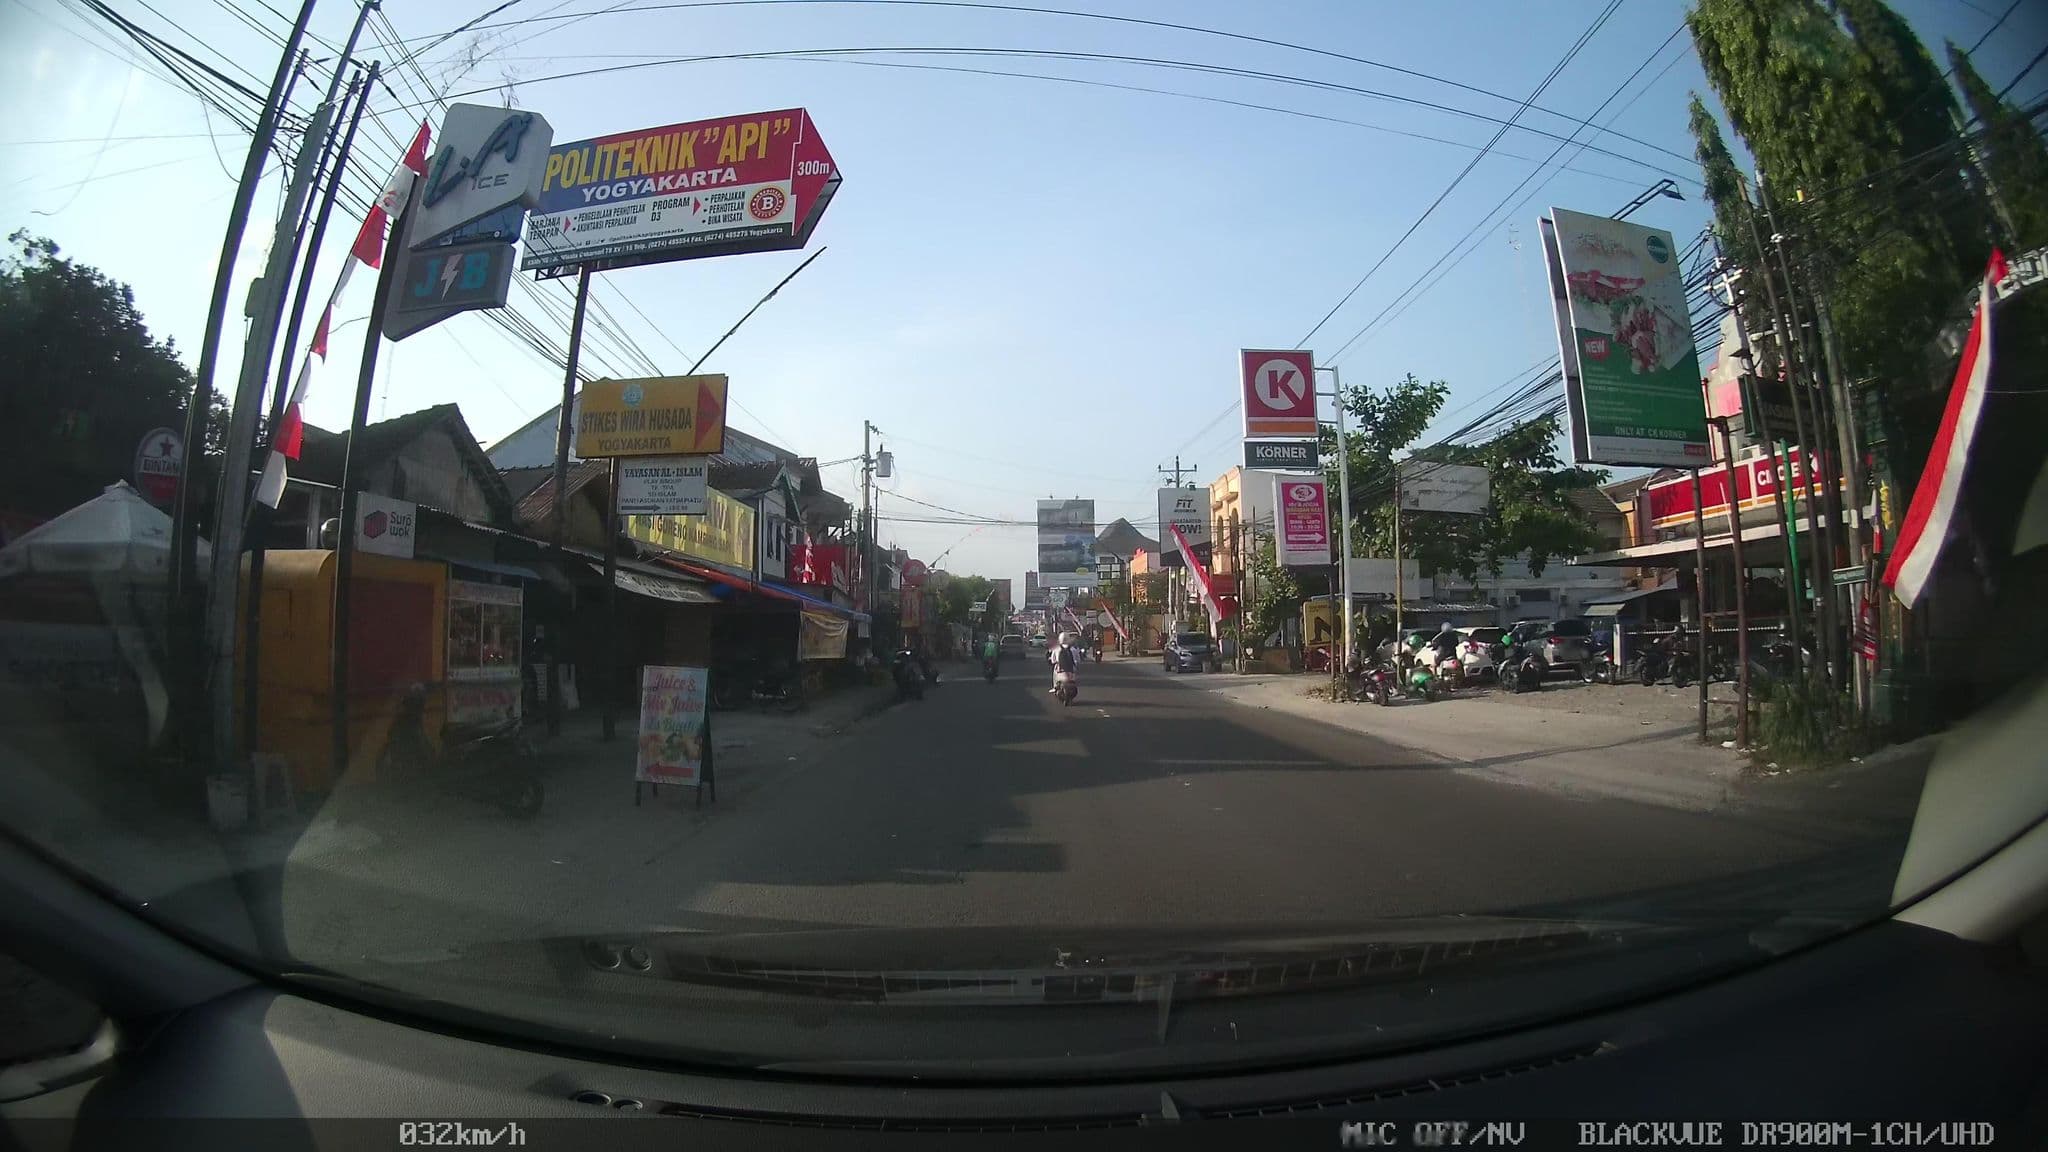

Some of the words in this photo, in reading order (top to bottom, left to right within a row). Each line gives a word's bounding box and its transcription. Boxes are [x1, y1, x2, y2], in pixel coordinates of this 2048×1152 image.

[543, 129, 701, 192] POLITEKNIK
[797, 160, 830, 177] 300m
[582, 167, 738, 203] YOGYAKARTA
[652, 196, 690, 211] PROGRAM
[710, 191, 745, 204] PERPAJAKAN
[761, 197, 774, 210] B
[708, 201, 745, 214] PERHOTELAN
[650, 212, 662, 222] D3
[1584, 340, 1605, 354] NEW
[582, 411, 618, 433] STIKES
[621, 409, 646, 431] WIRA
[650, 407, 692, 430] HUSADA
[1615, 426, 1634, 436] ONLY
[1635, 427, 1645, 436] AT
[598, 437, 672, 451] YOGYAKARTA
[1176, 499, 1193, 508] FIT
